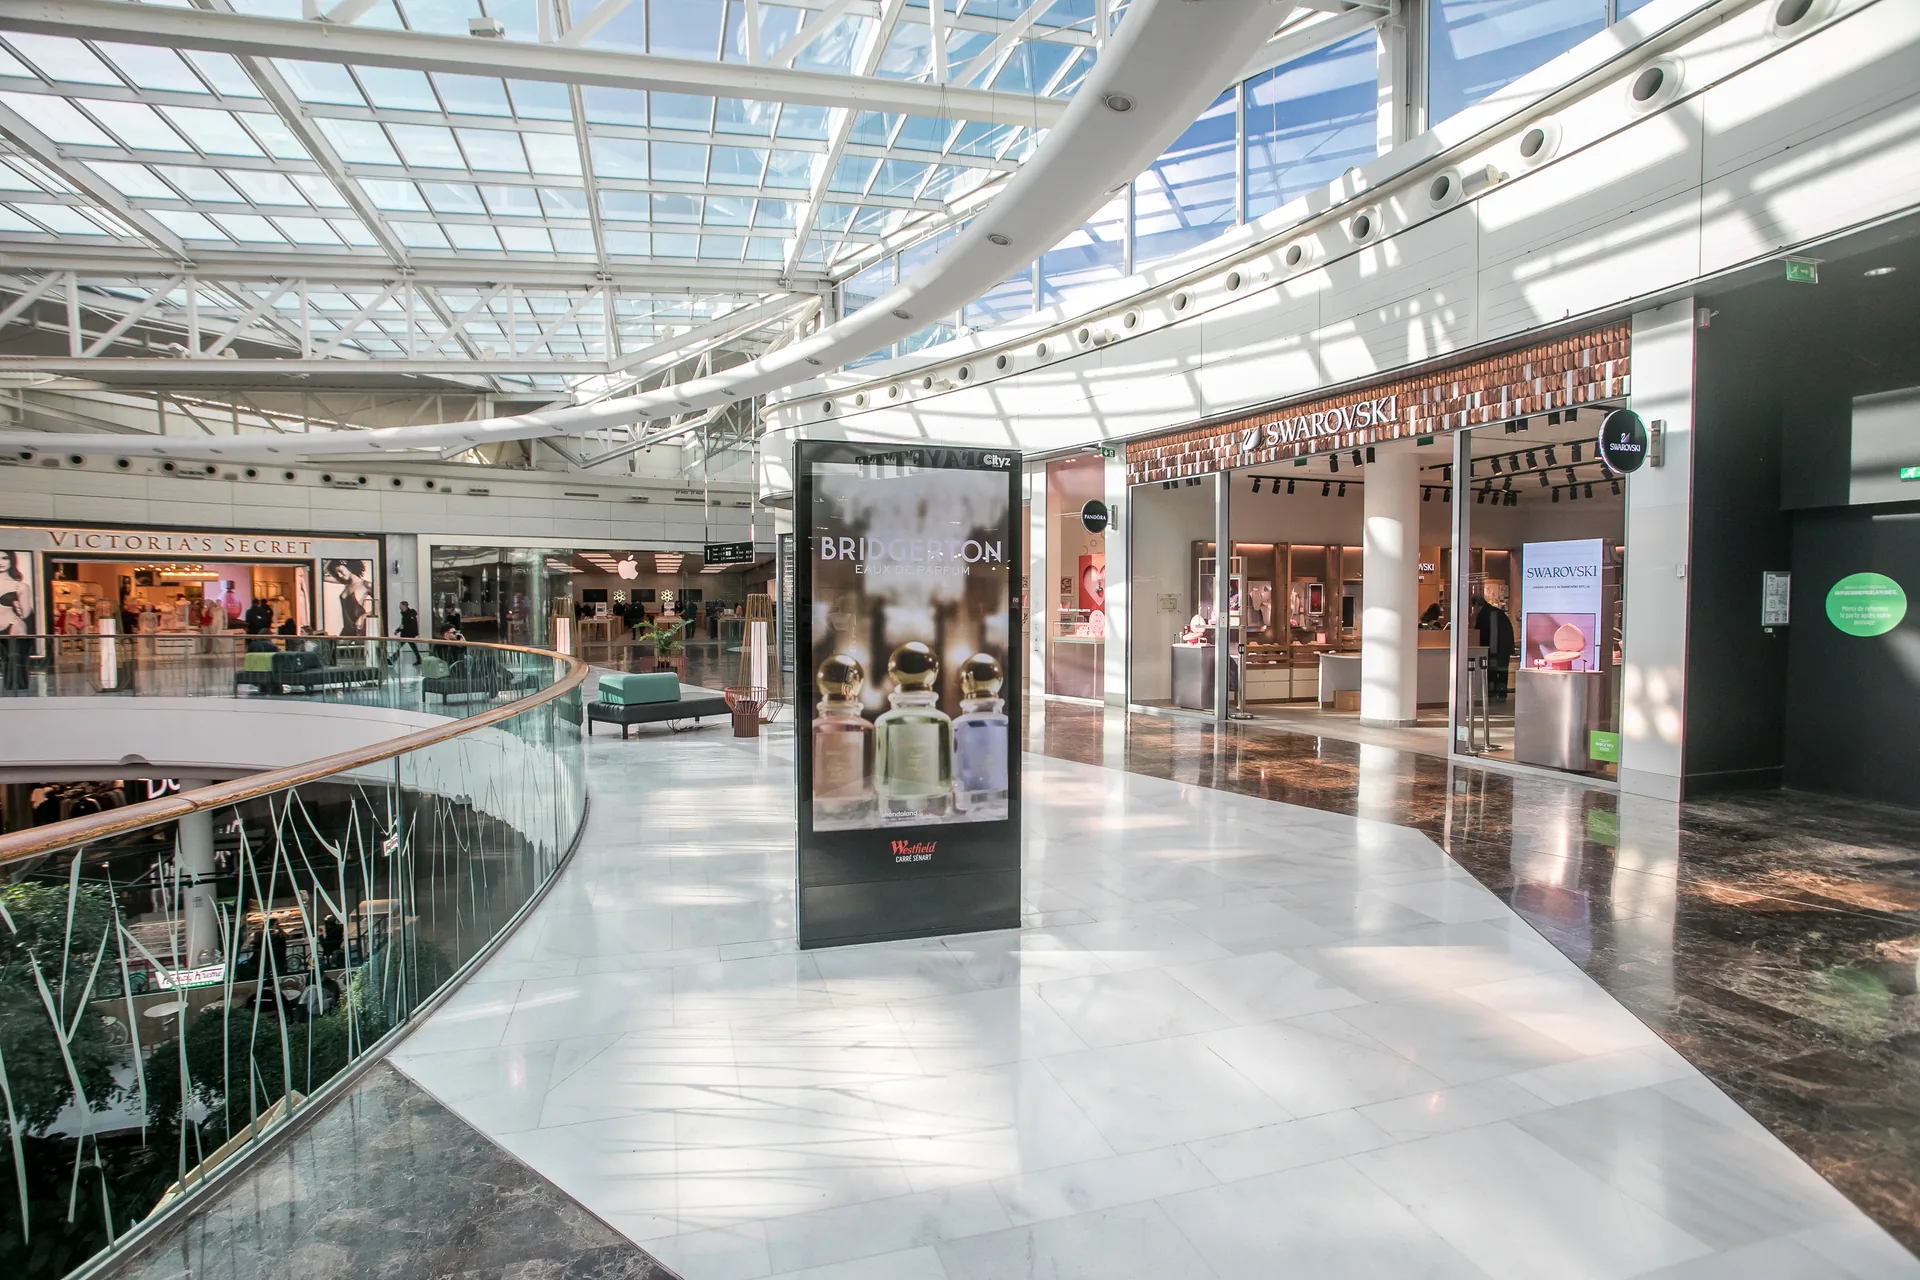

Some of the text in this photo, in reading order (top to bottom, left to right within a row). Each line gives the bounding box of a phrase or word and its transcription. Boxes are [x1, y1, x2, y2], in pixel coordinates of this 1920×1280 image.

[1266, 395, 1398, 446] SWAROVSKI
[1609, 442, 1641, 452] SWAROVSKI
[983, 453, 1011, 468] Cityz
[47, 531, 312, 554] VICTORIA'S SECRET
[821, 536, 1001, 563] BRIDGERTON
[855, 564, 970, 577] EAUX DE PARFUM
[1526, 565, 1598, 579] SWAROVSKI
[890, 839, 938, 855] Westfield
[895, 853, 932, 863] CARRÉ SÉNART
